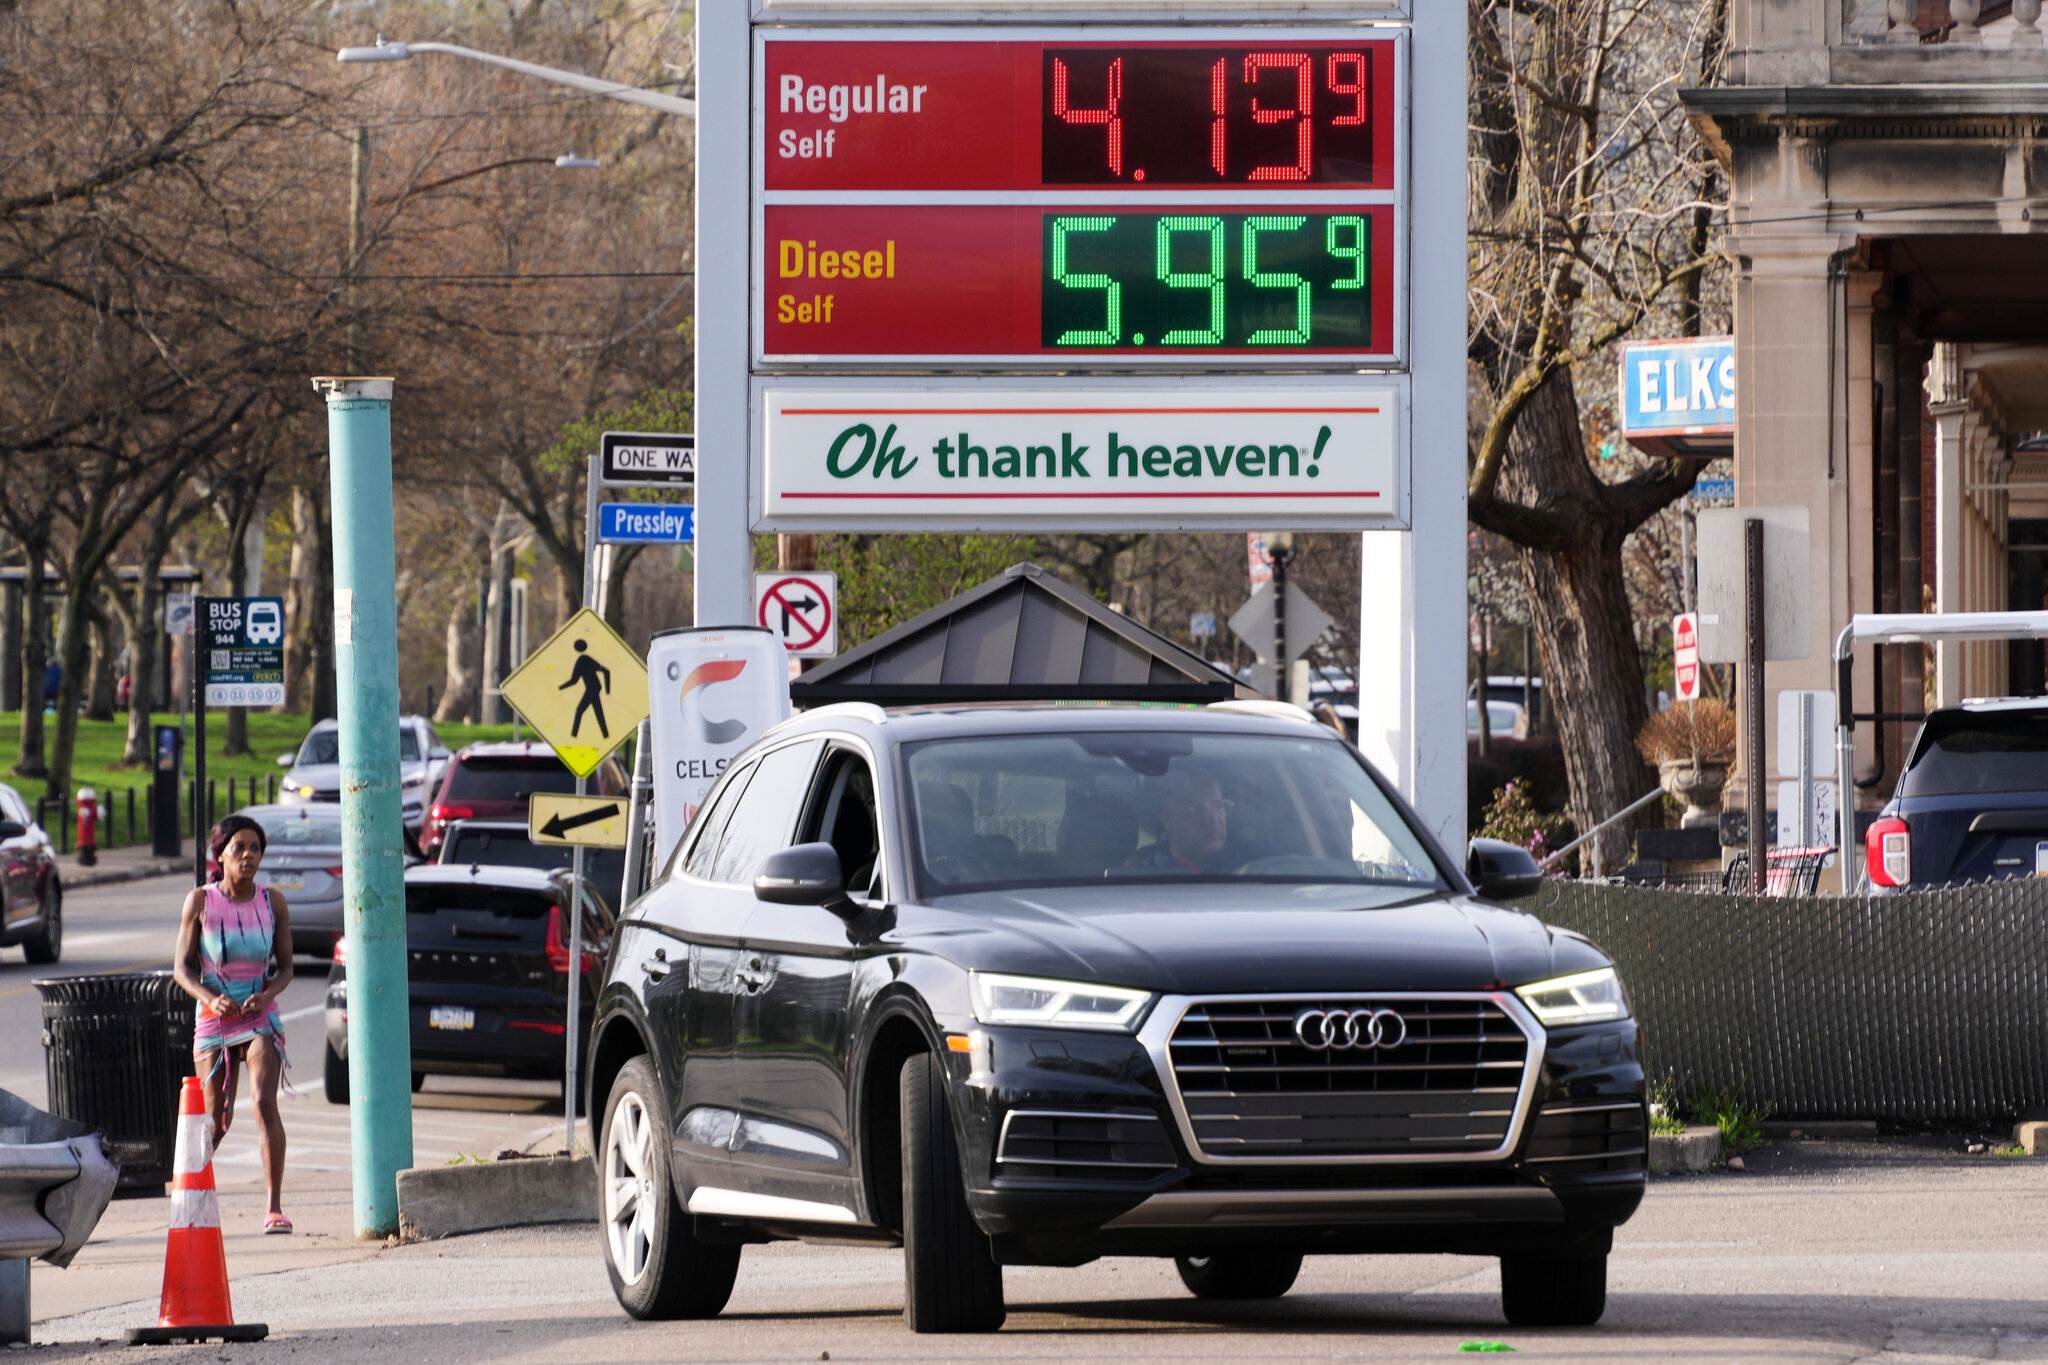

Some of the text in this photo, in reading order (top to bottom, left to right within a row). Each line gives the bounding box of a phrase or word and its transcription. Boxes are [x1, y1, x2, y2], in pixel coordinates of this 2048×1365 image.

[778, 74, 927, 122] Regular
[778, 129, 836, 158] Self
[778, 240, 896, 278] Diesel
[778, 294, 834, 323] Self
[1638, 355, 1734, 413] ELKS
[618, 449, 695, 468] ONE WA
[826, 423, 919, 479] Oh
[932, 432, 1091, 478] thank
[615, 508, 684, 540] Pressley
[209, 602, 242, 618] BUS
[209, 618, 242, 631] STOP
[215, 634, 235, 645] 944
[216, 691, 223, 700] 8
[233, 691, 242, 700] 11
[268, 690, 278, 699] 17
[676, 758, 734, 779] CELS
[413, 952, 497, 963] VOLVO
